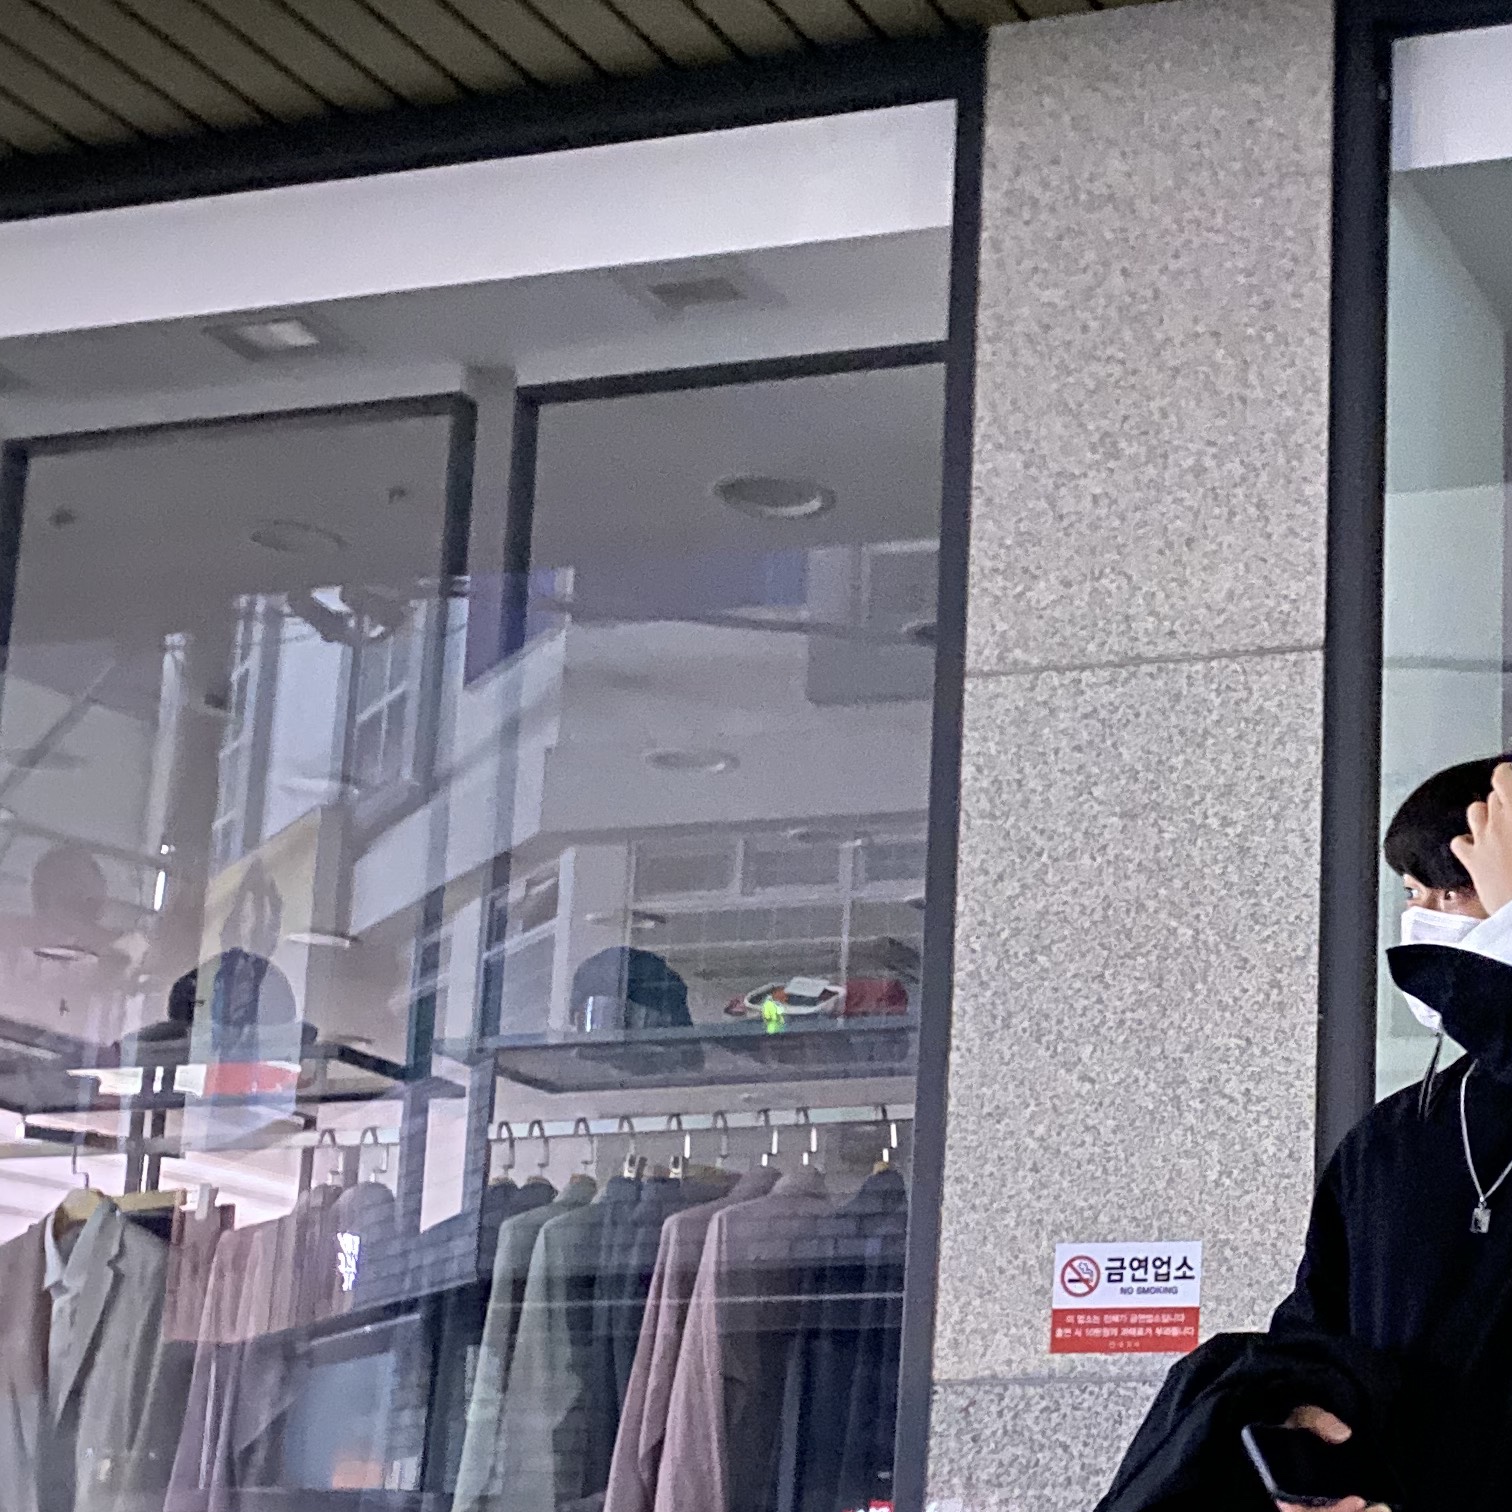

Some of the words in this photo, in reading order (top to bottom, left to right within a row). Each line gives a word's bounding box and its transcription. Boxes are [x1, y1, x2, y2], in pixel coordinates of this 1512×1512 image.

[1105, 1256, 1195, 1283] 금연업소
[1120, 1286, 1134, 1294] NO
[1136, 1286, 1178, 1295] SMOKING
